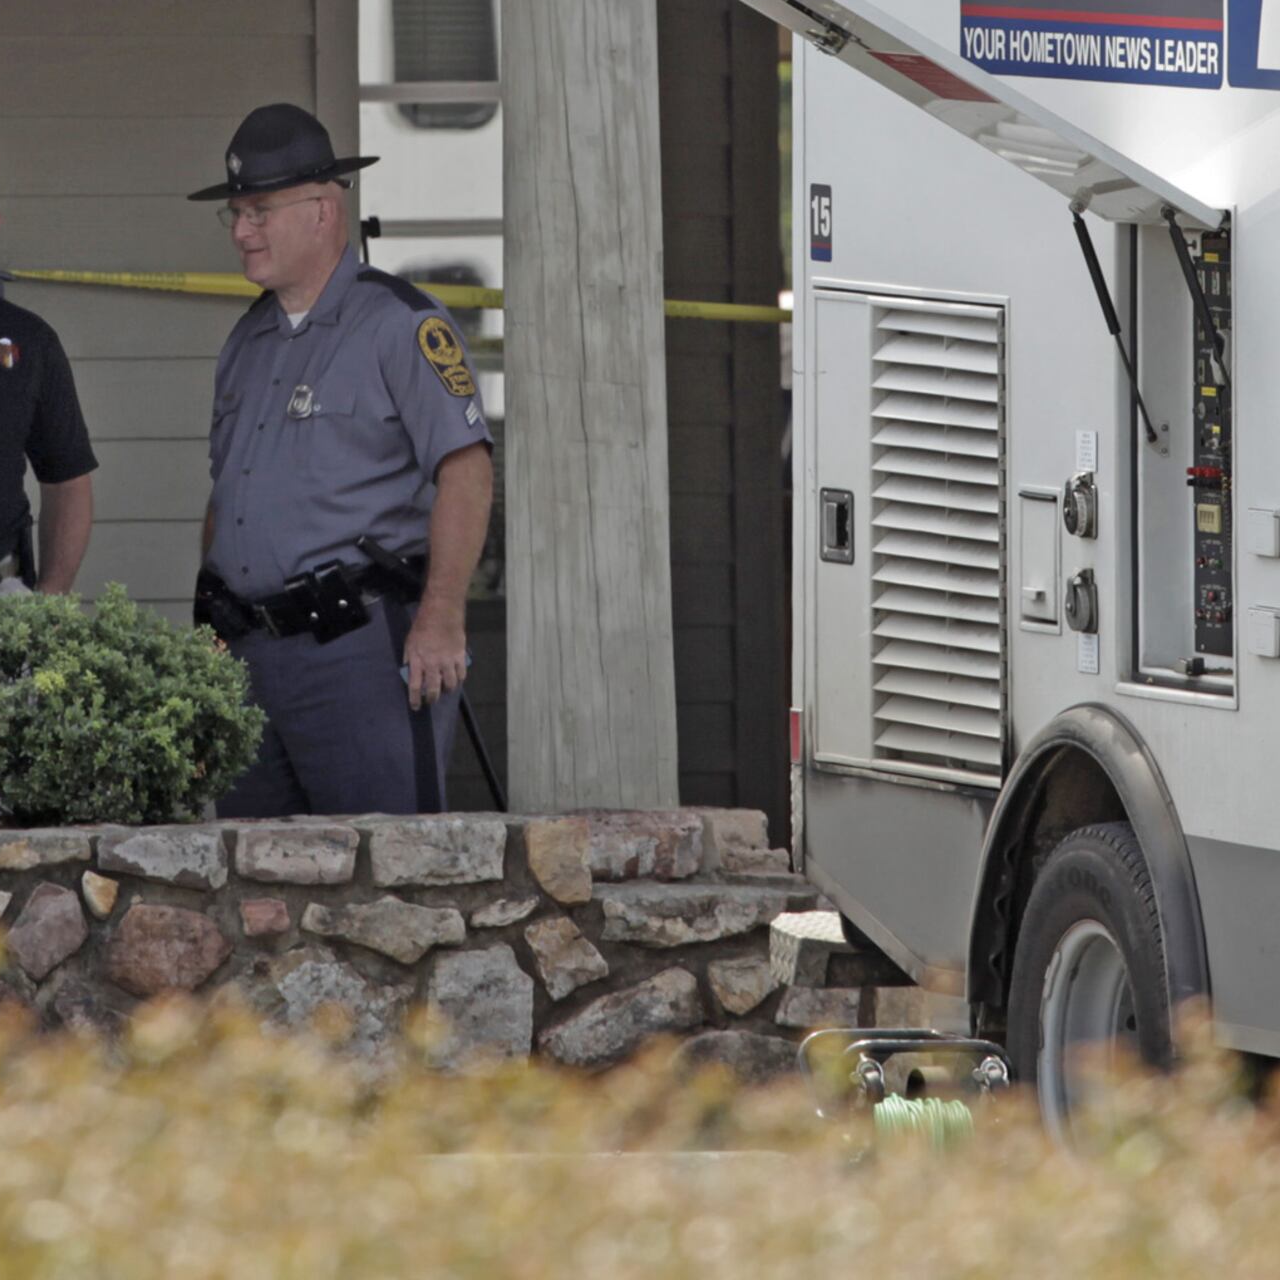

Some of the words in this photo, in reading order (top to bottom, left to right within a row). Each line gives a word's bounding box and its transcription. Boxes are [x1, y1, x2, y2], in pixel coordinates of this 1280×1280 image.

[963, 27, 1006, 61] YOUR
[1009, 30, 1101, 67] HOMETOWN
[1104, 35, 1152, 72] NEWS
[1155, 38, 1218, 75] LEADER
[811, 194, 831, 238] 15
